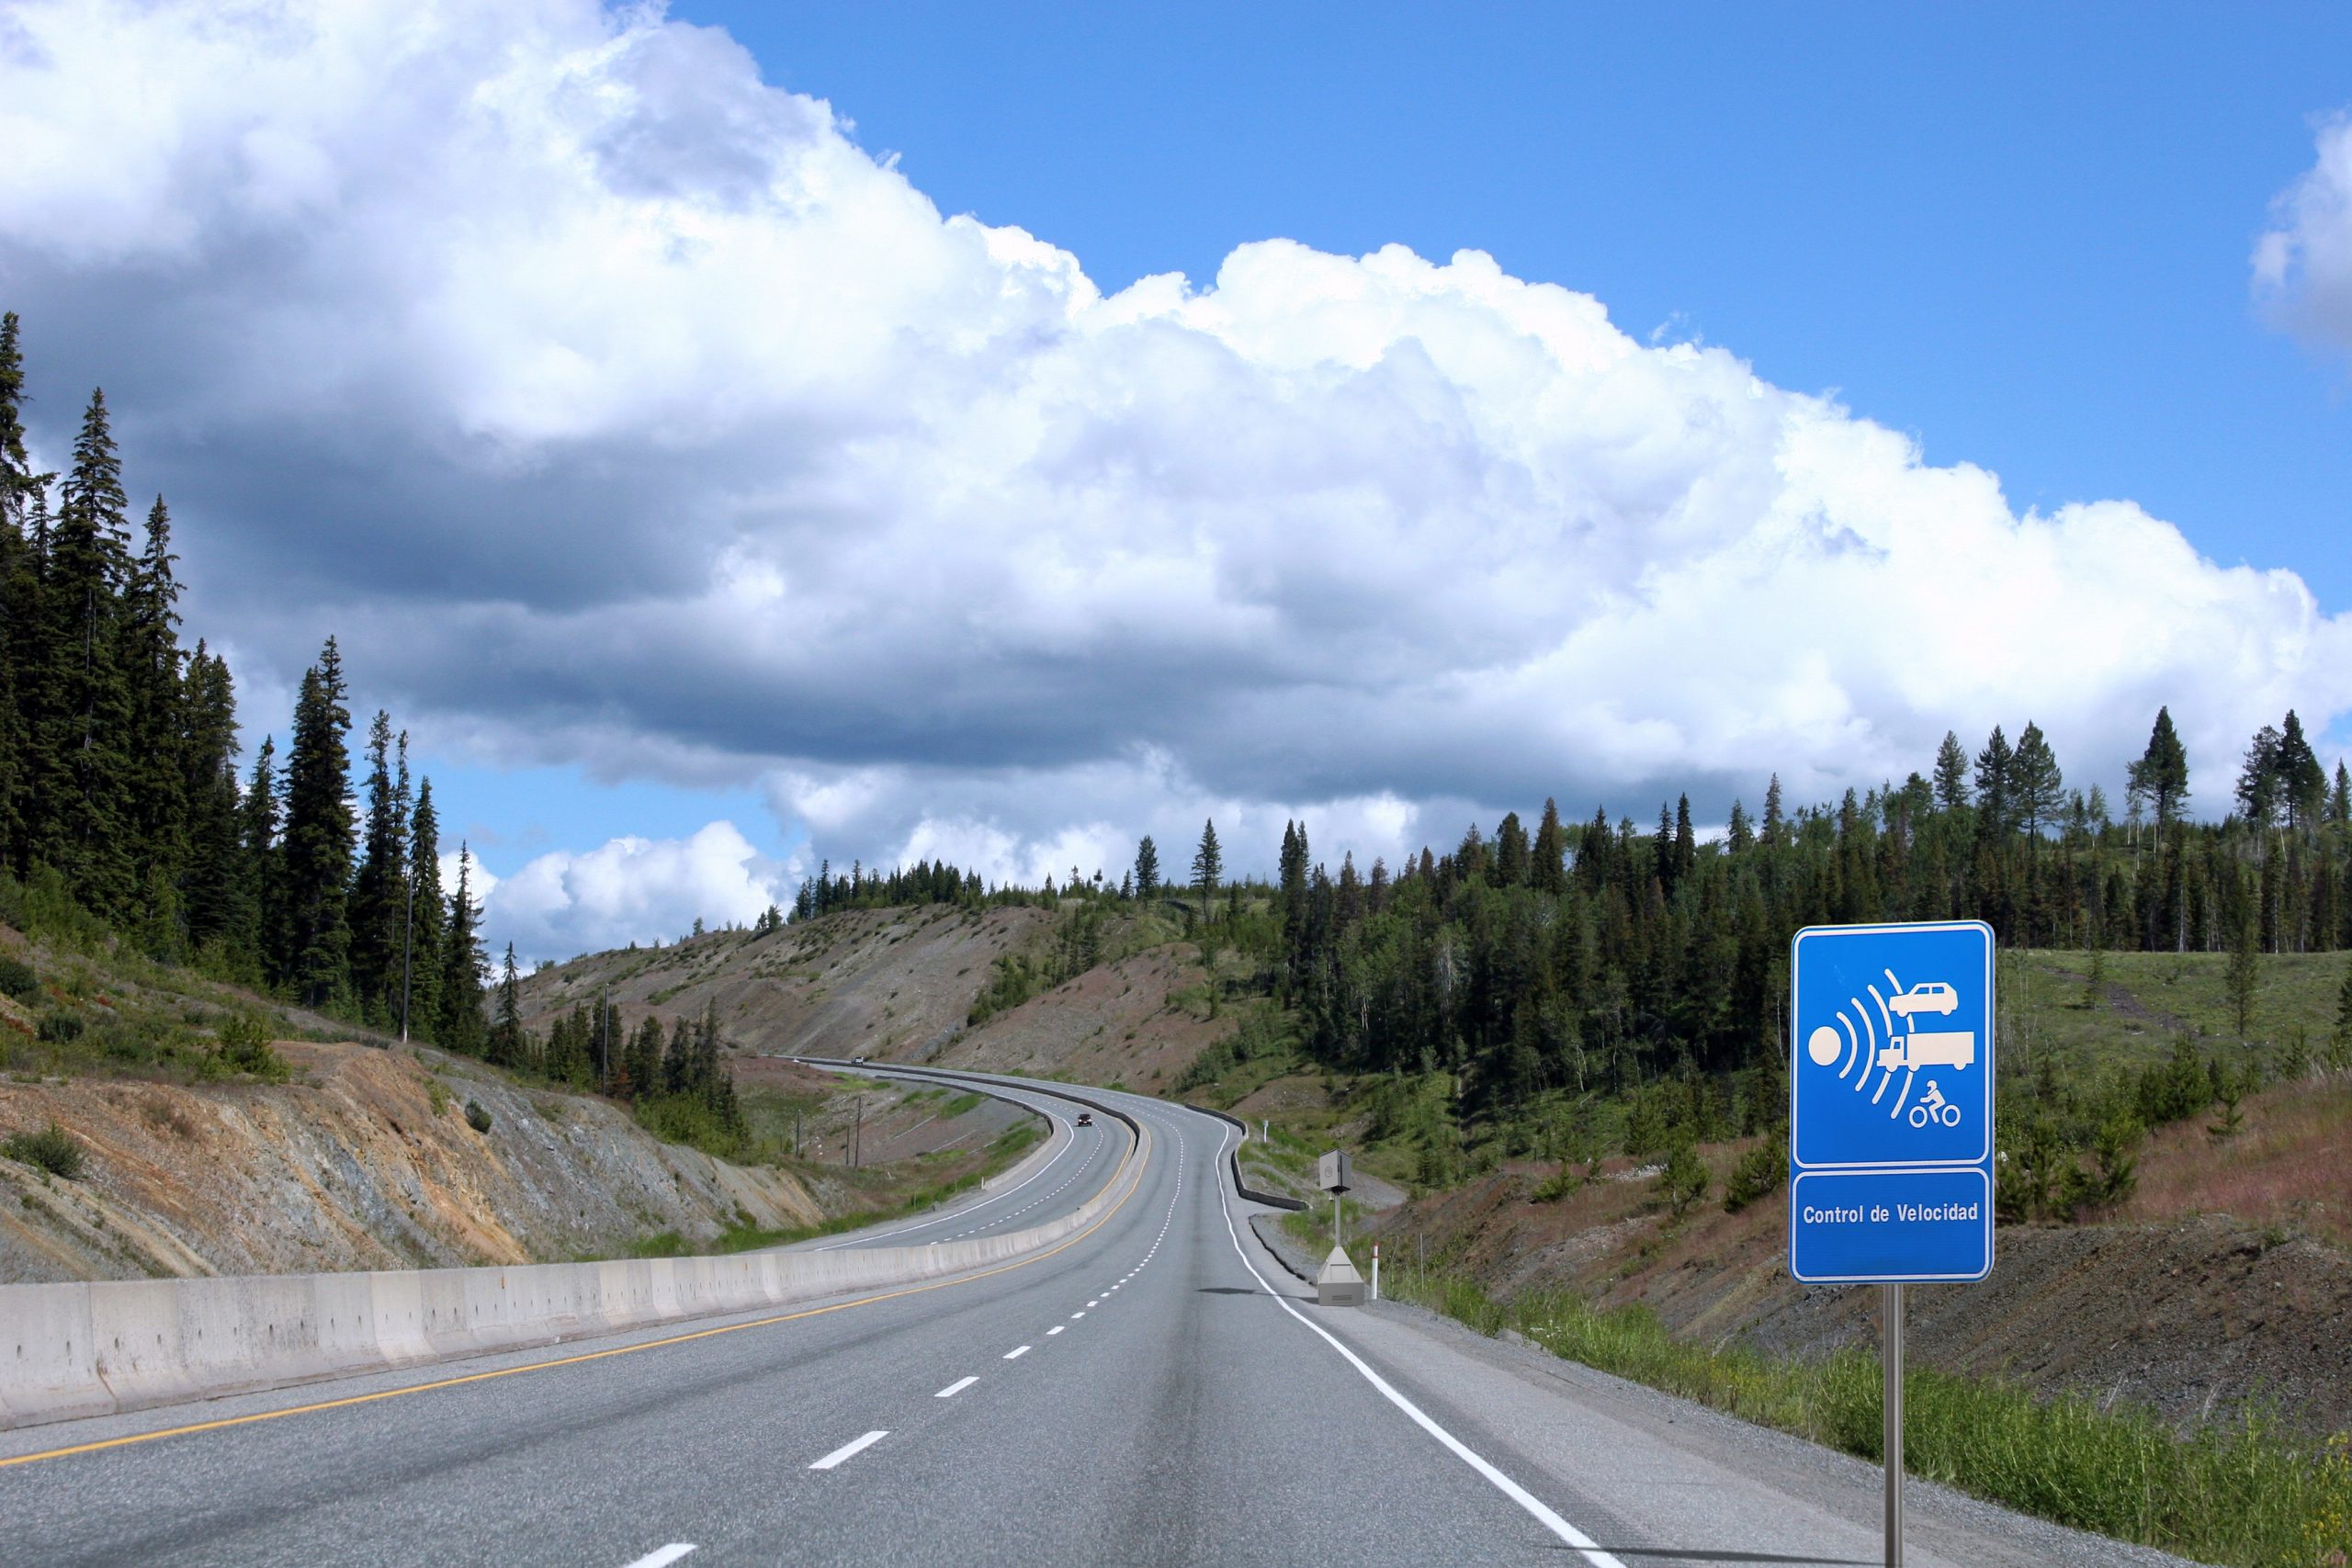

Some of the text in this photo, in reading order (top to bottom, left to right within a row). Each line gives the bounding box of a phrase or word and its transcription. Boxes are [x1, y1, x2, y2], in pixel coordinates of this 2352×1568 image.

[1804, 1202, 1978, 1224] Control de Velocidad
